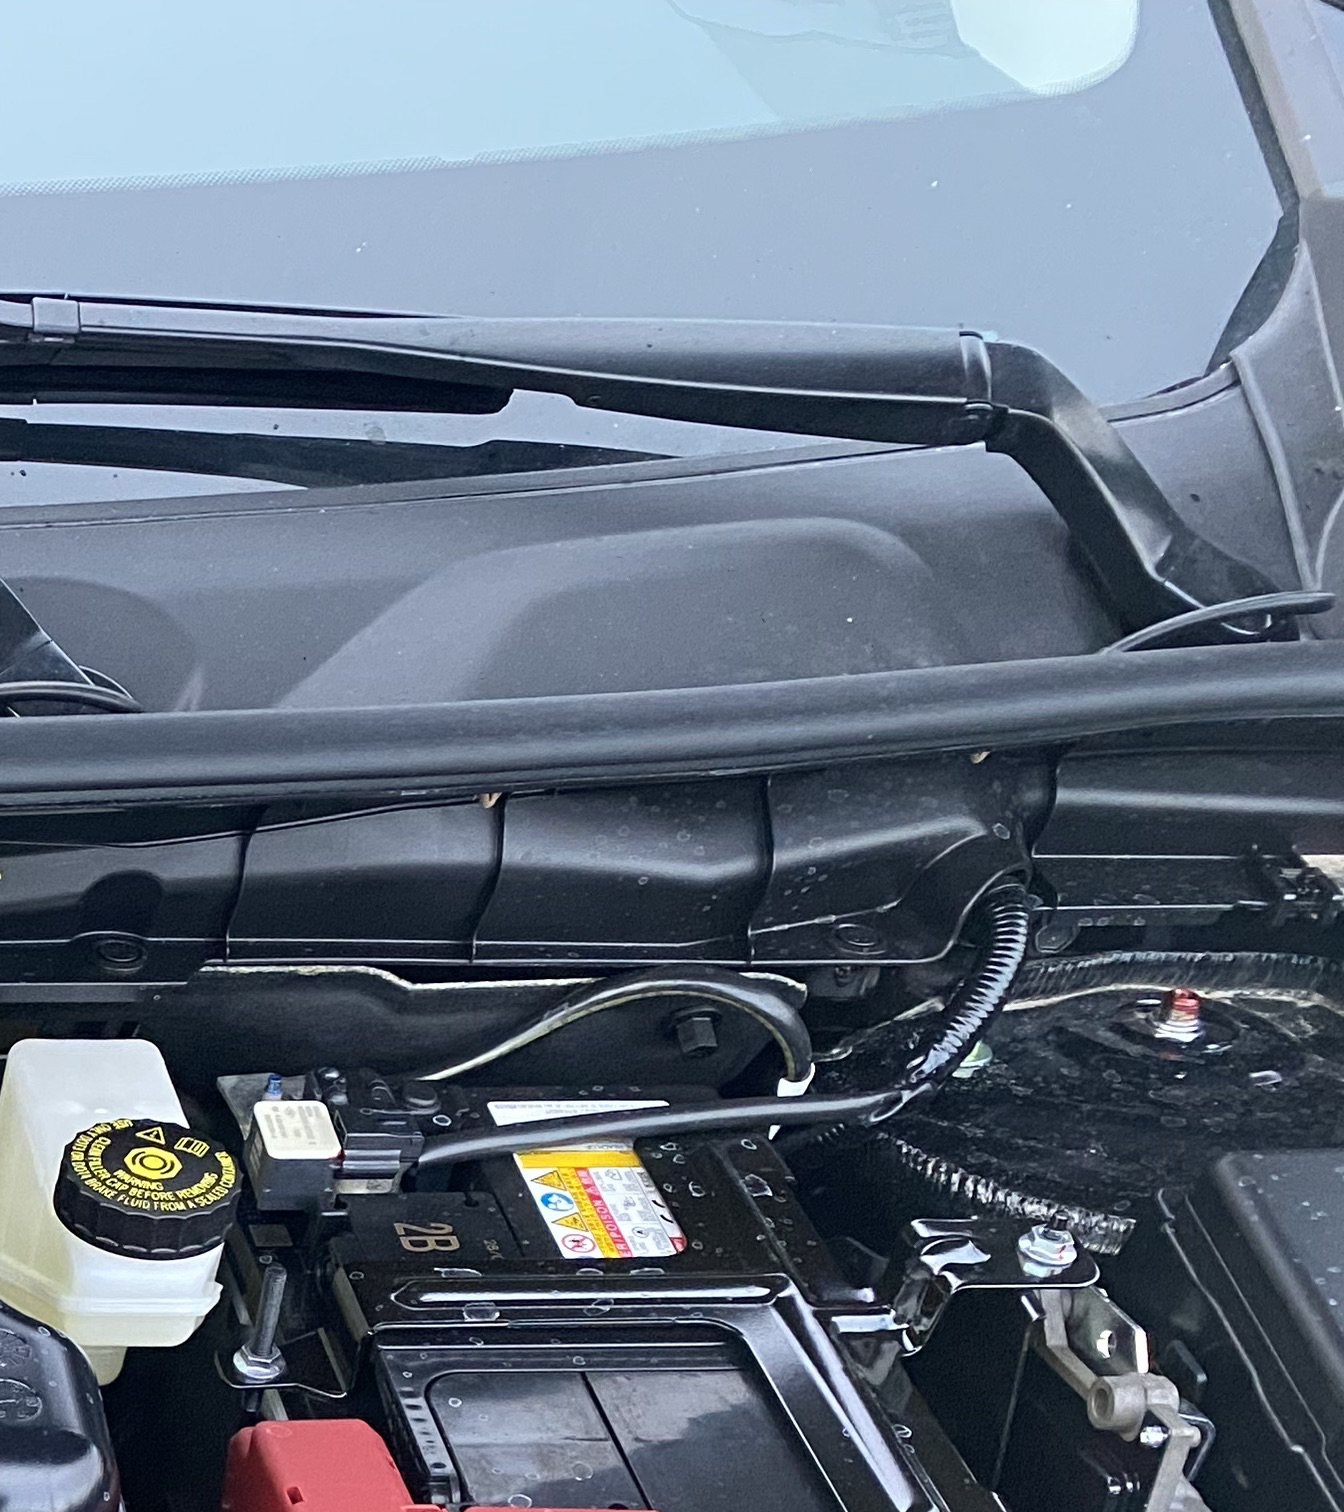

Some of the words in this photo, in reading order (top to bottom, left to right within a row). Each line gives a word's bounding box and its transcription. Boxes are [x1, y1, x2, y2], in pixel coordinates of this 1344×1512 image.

[106, 1177, 129, 1192] CAP
[129, 1187, 176, 1201] BEFORE
[113, 1169, 164, 1191] WARNING
[85, 1178, 116, 1200] BRAKE
[117, 1194, 150, 1210] FLUID
[154, 1202, 186, 1212] FROM
[188, 1201, 197, 1209] A
[196, 1183, 229, 1208] SEALED
